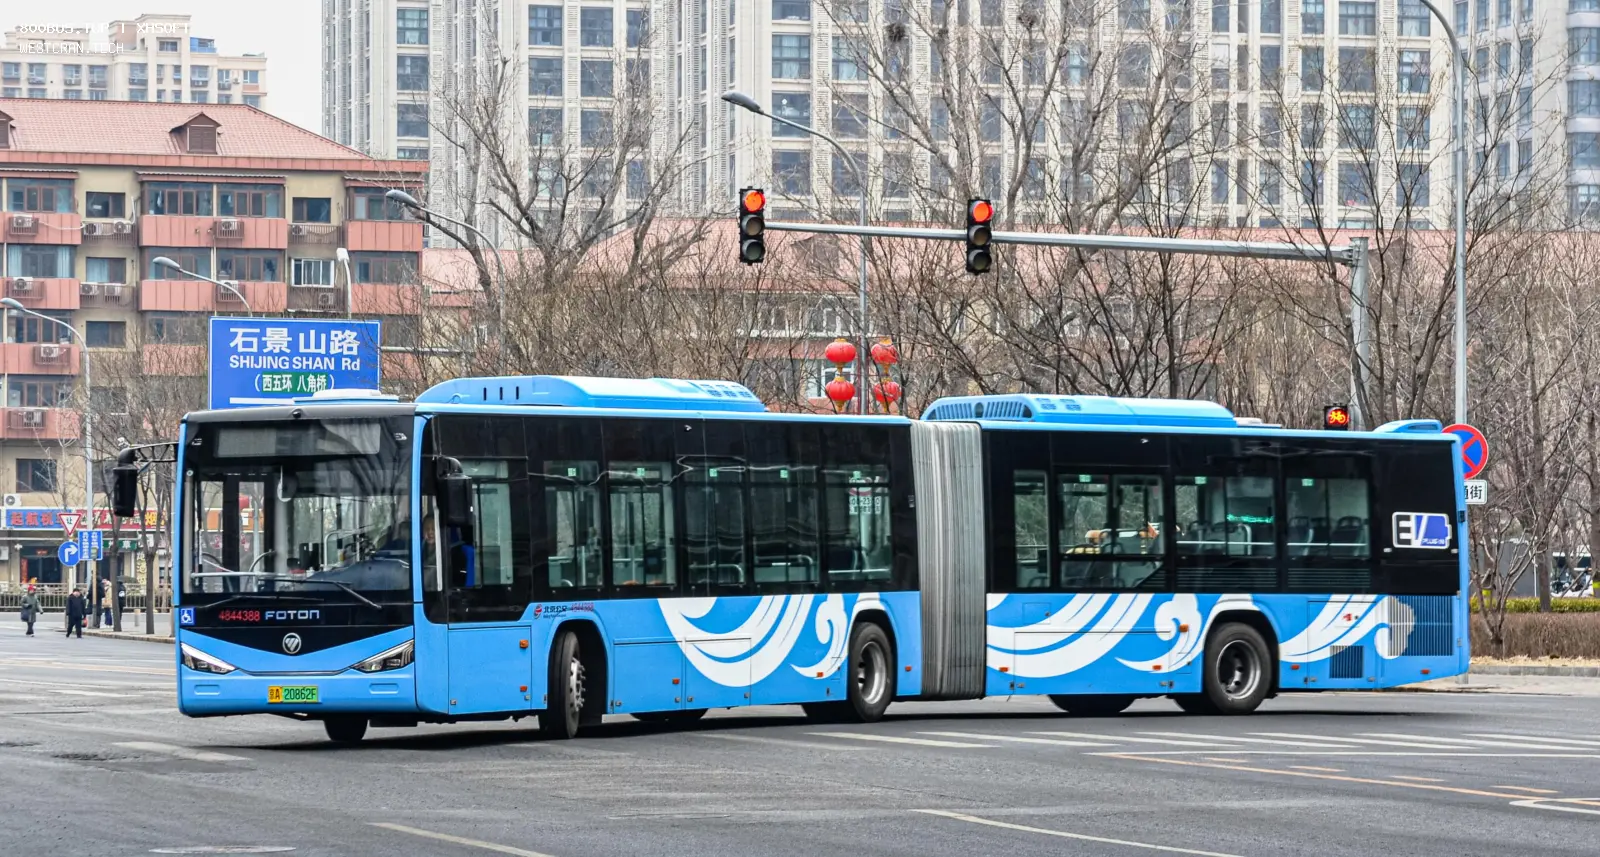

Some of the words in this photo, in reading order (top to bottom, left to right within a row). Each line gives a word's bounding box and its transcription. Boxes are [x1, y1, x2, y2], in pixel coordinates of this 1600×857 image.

[229, 327, 360, 355] 石景山路
[229, 355, 290, 369] SHIJING
[292, 356, 335, 370] SHAN
[341, 358, 360, 371] Rd
[219, 610, 260, 621] 4844388
[265, 610, 320, 620] FOTON
[284, 688, 317, 700] 20862F
